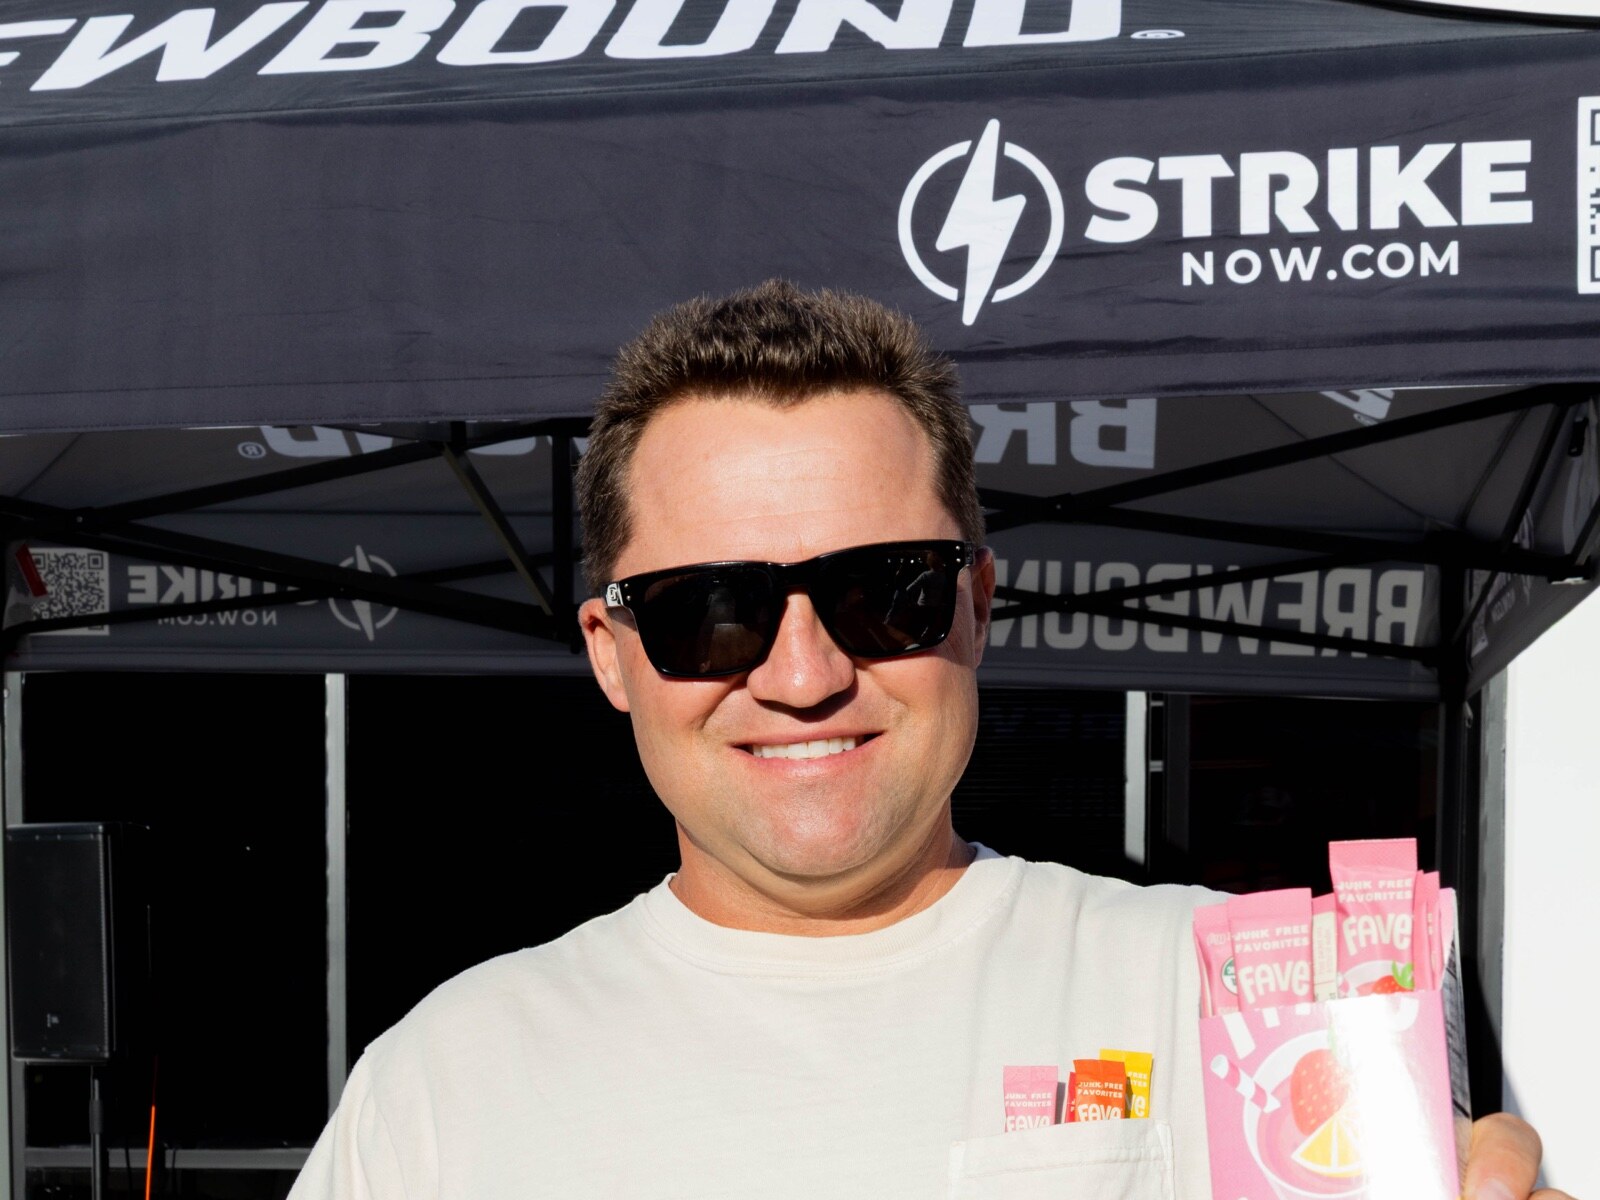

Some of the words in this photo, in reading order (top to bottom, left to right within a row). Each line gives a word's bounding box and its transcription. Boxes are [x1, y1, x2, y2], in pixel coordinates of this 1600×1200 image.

[1084, 140, 1533, 243] STRIKE
[1181, 241, 1460, 287] NOW.COM
[1337, 880, 1372, 890] JUNK
[1378, 878, 1412, 889] FREE
[1338, 890, 1412, 903] FAVORITES
[1234, 928, 1269, 941] JUNK
[1275, 924, 1308, 937] FREE
[1235, 937, 1308, 953] FAVORITES
[1104, 1082, 1123, 1090] FREE
[1078, 1089, 1123, 1099] FAVORITES
